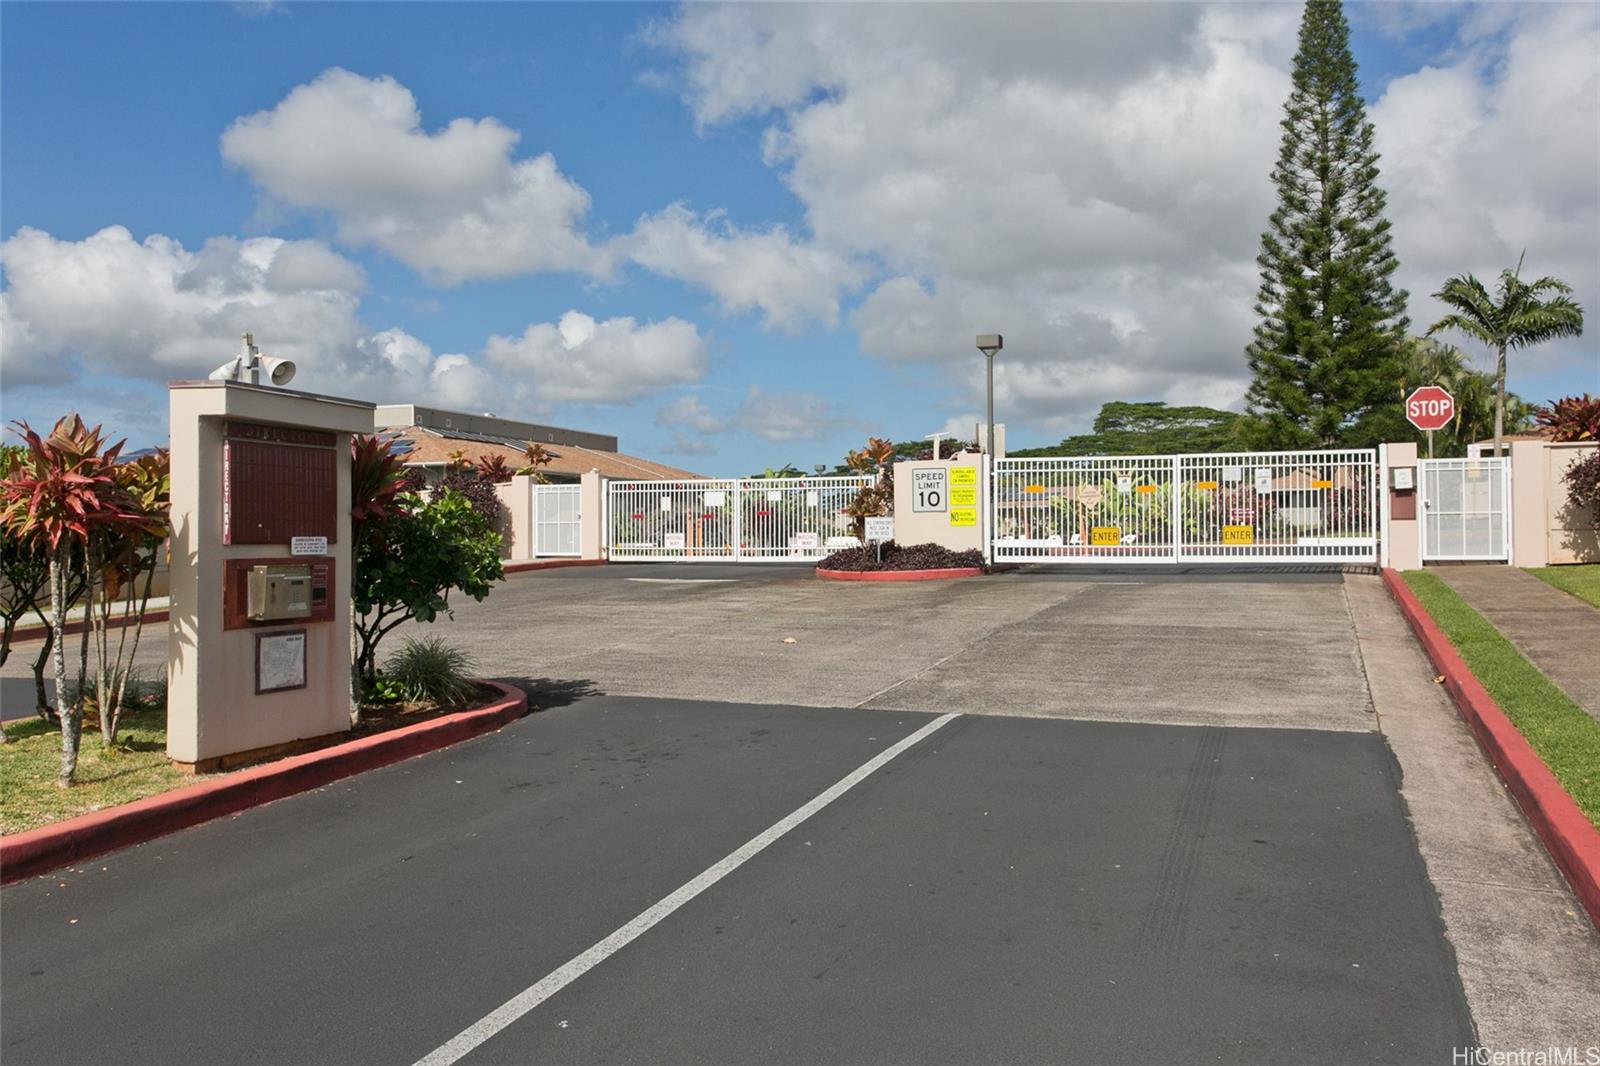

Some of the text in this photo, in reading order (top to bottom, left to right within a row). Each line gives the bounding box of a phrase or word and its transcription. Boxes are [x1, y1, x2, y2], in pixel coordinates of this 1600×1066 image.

[1410, 399, 1451, 417] STOP
[915, 472, 944, 481] SPEED
[918, 482, 941, 490] LIMIT
[919, 491, 941, 507] 10
[950, 511, 960, 522] NO
[1093, 532, 1118, 541] ENTER
[1225, 530, 1251, 540] ENTER
